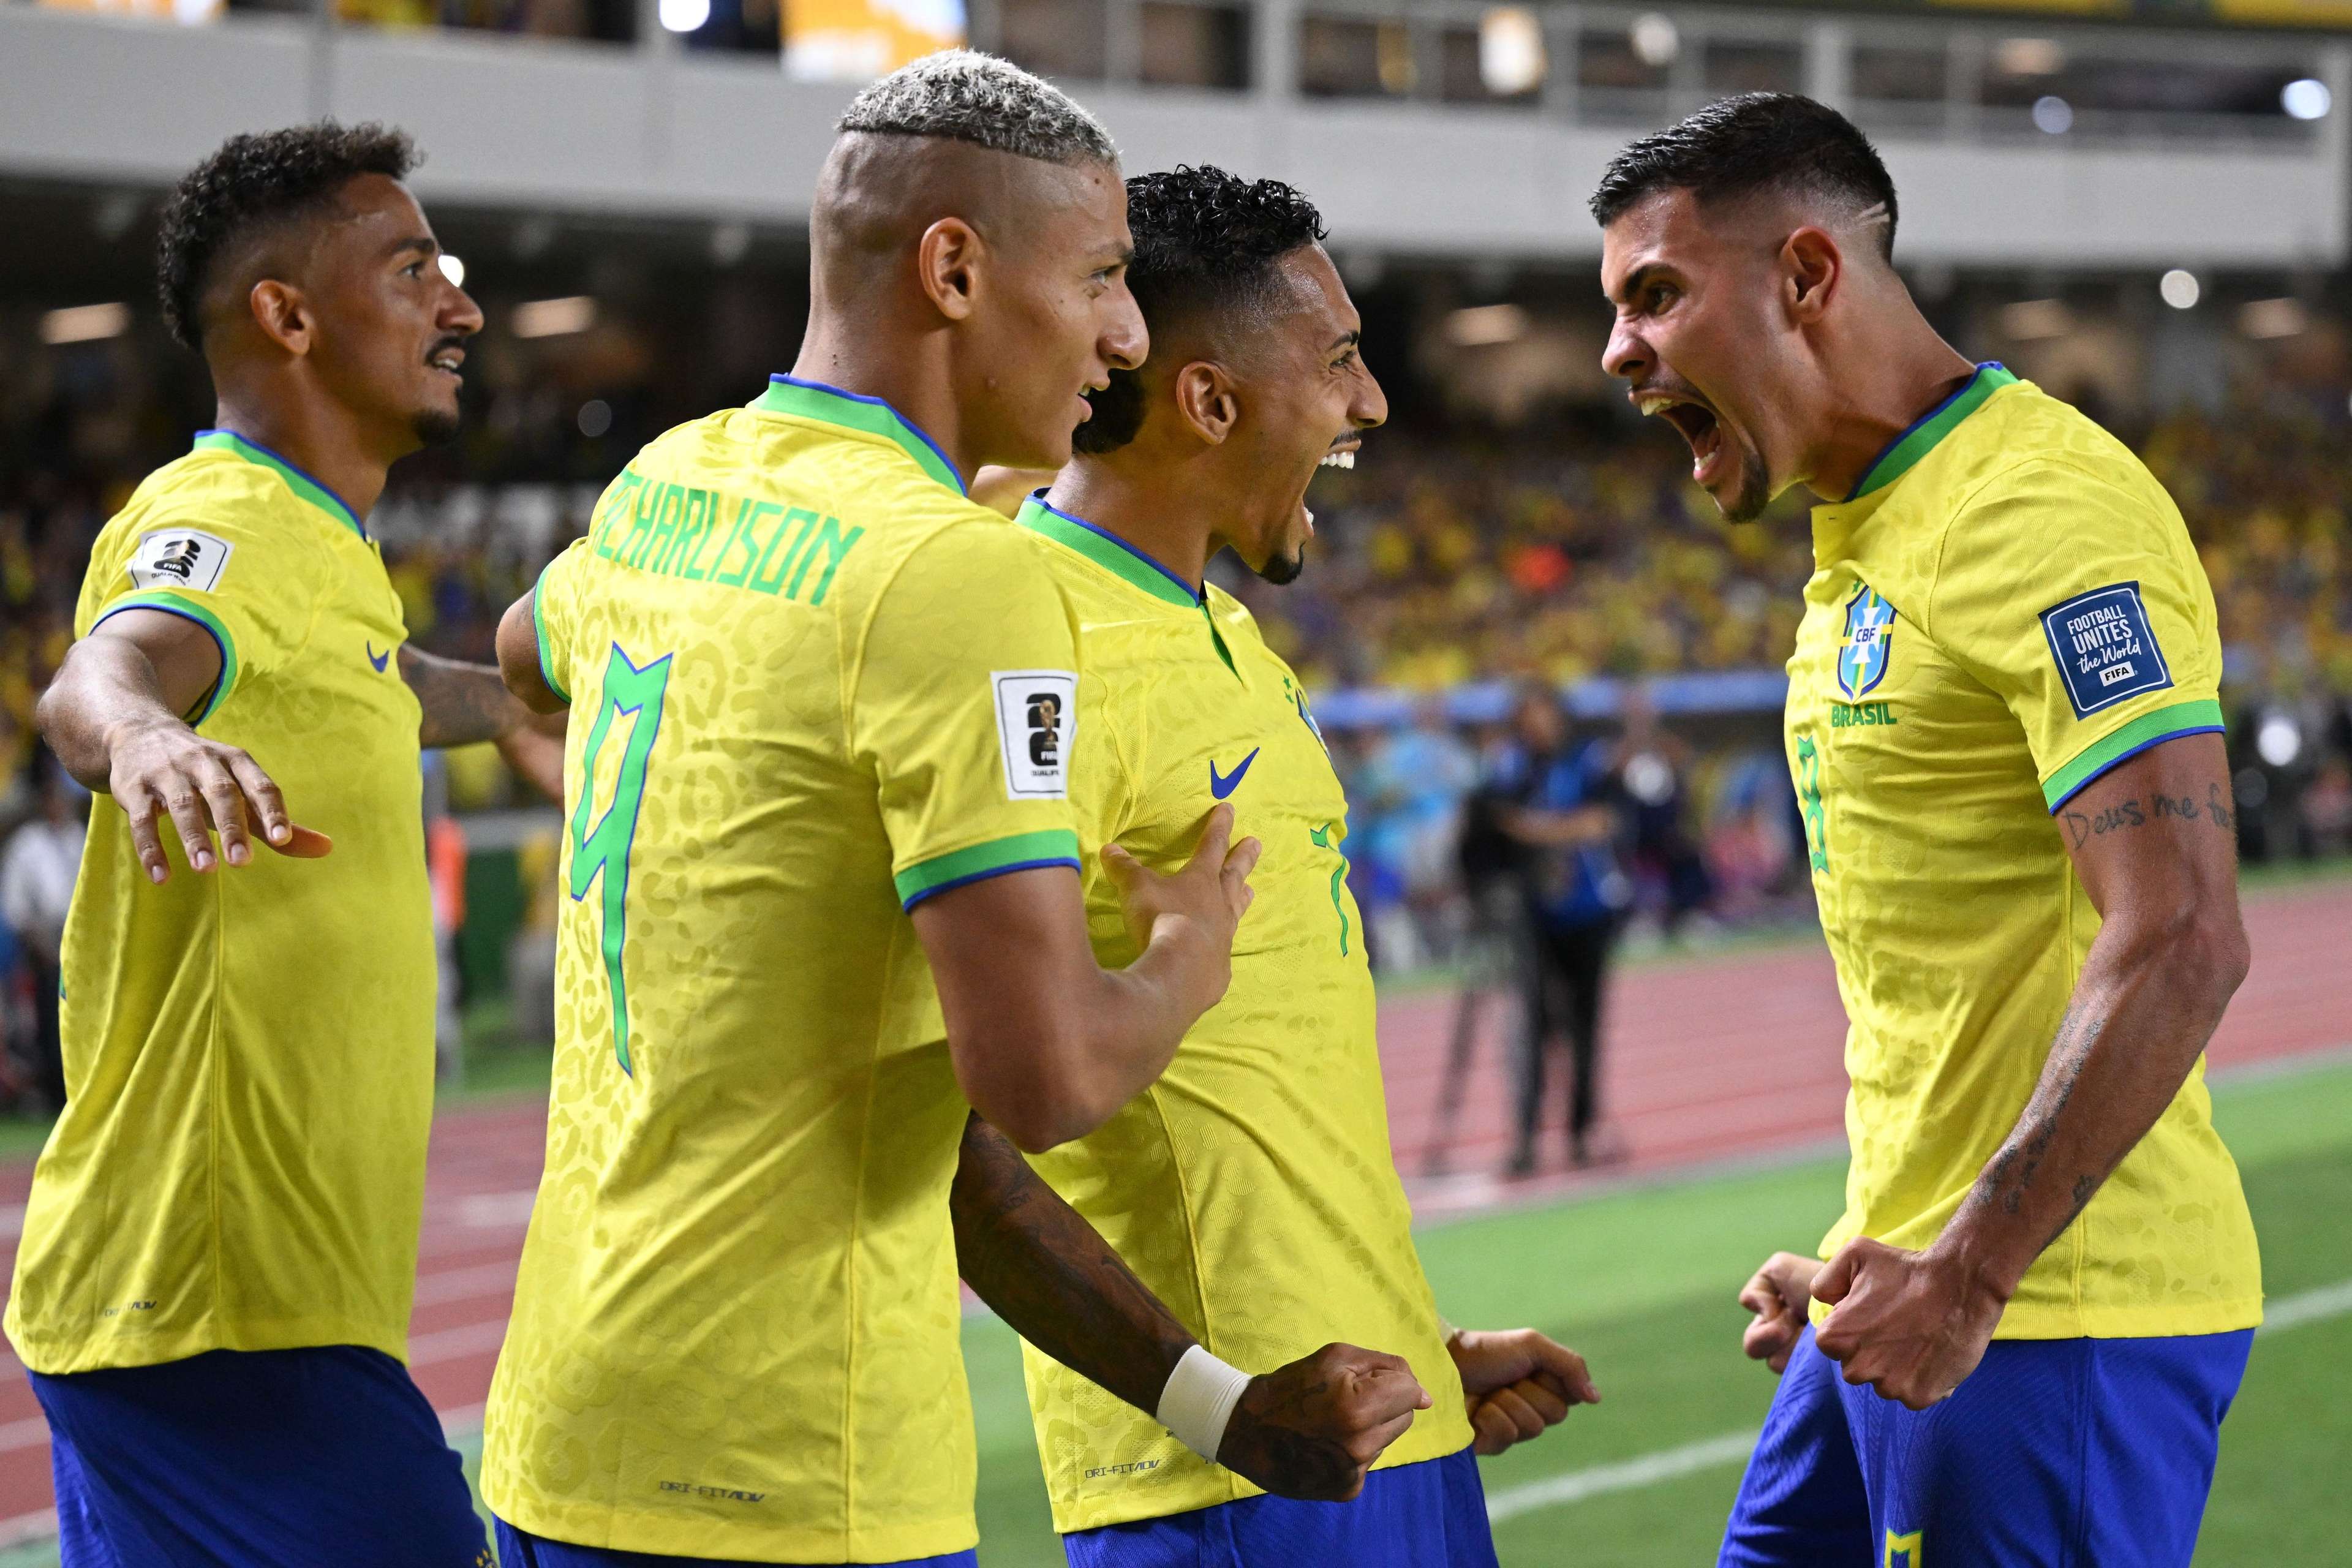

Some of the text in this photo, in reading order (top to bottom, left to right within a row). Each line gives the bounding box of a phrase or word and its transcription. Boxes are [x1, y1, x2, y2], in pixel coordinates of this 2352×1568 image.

[593, 467, 865, 606] CHARLISON
[1855, 627, 1876, 643] CBF
[2067, 604, 2127, 635] FOOTBALL
[2072, 619, 2133, 654] UNITES
[2076, 638, 2141, 674] the World
[2104, 666, 2130, 682] FIFA
[1831, 703, 1897, 728] BRASIL
[1797, 735, 1830, 874] 8
[571, 641, 673, 1079] 9
[1310, 823, 1348, 957] 7
